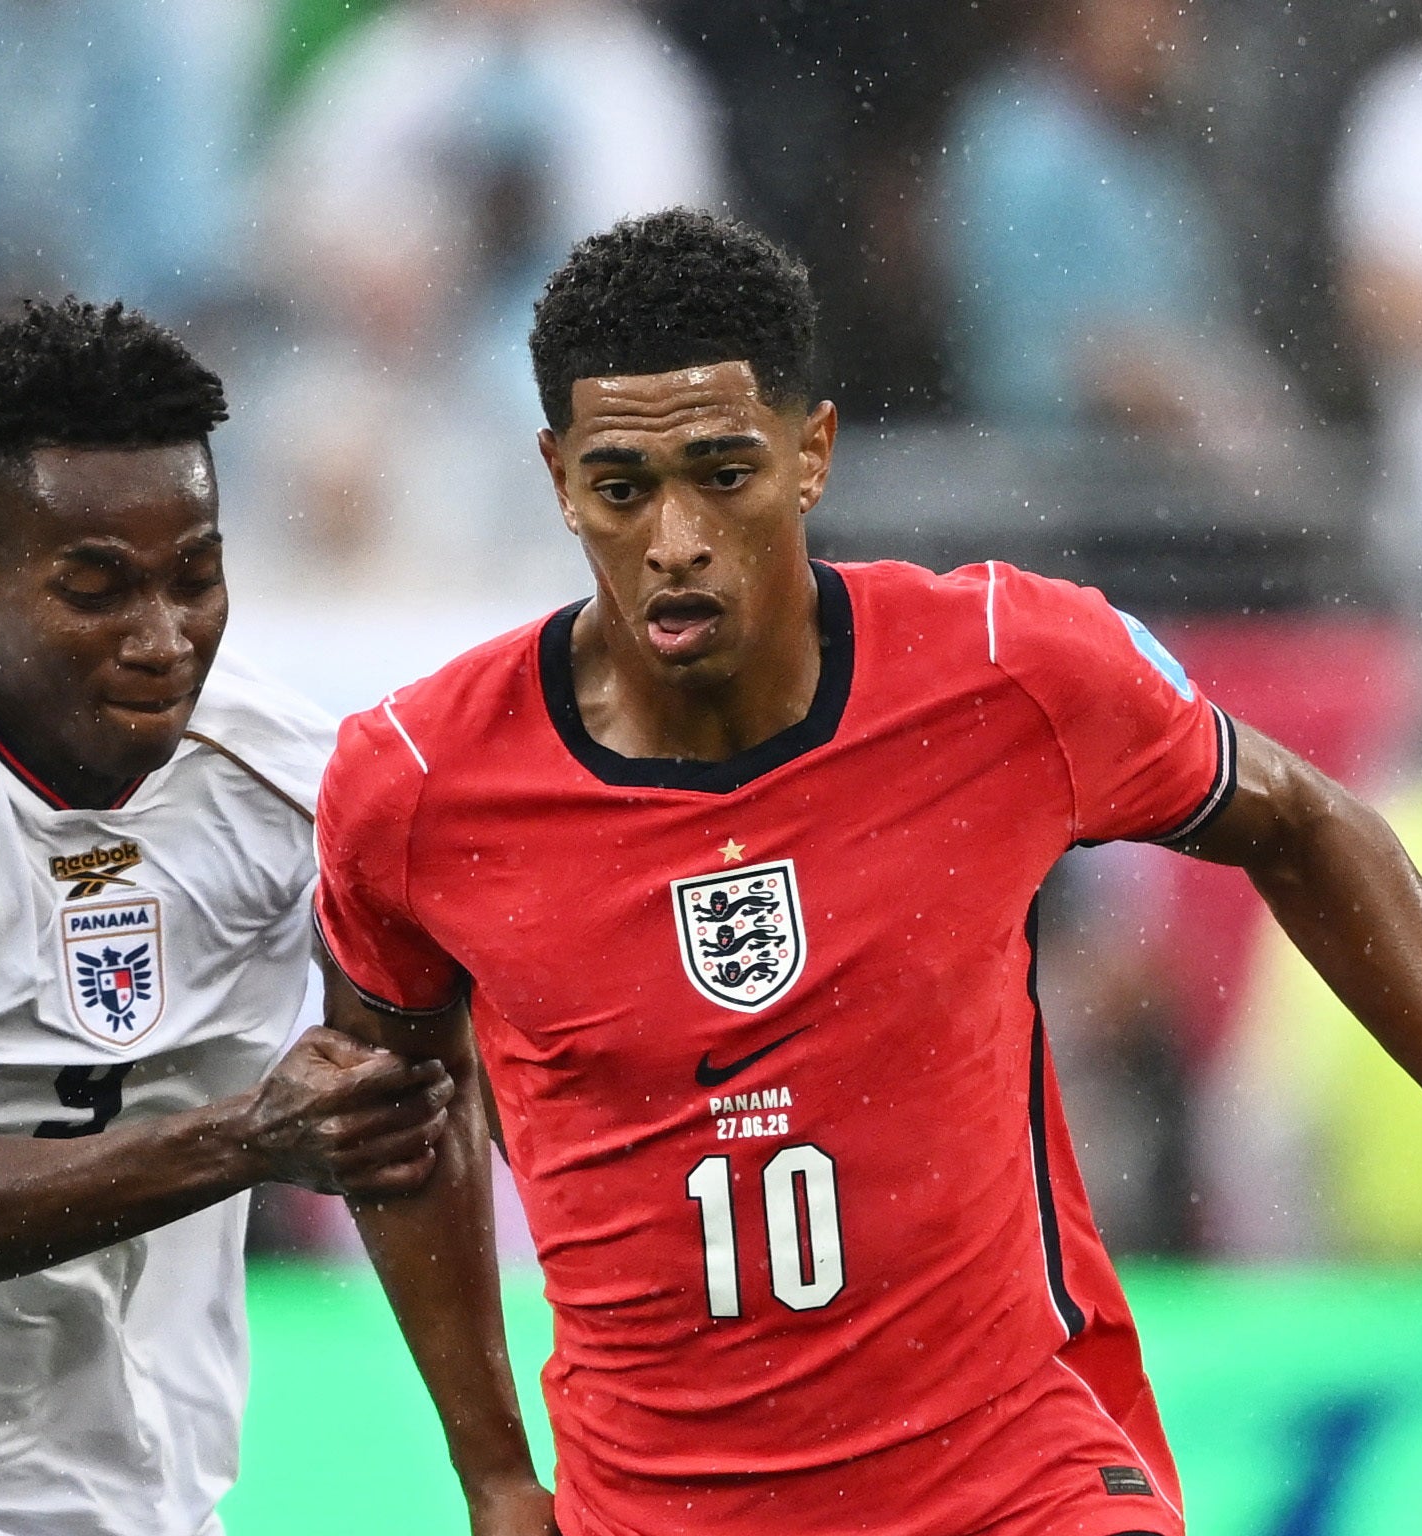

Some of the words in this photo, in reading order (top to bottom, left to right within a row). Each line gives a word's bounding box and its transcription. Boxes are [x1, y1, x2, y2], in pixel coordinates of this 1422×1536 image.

[49, 841, 140, 877] Reebok
[709, 1086, 793, 1116] PANAMA
[716, 1113, 789, 1140] 27.06.26
[685, 1142, 847, 1319] 10
